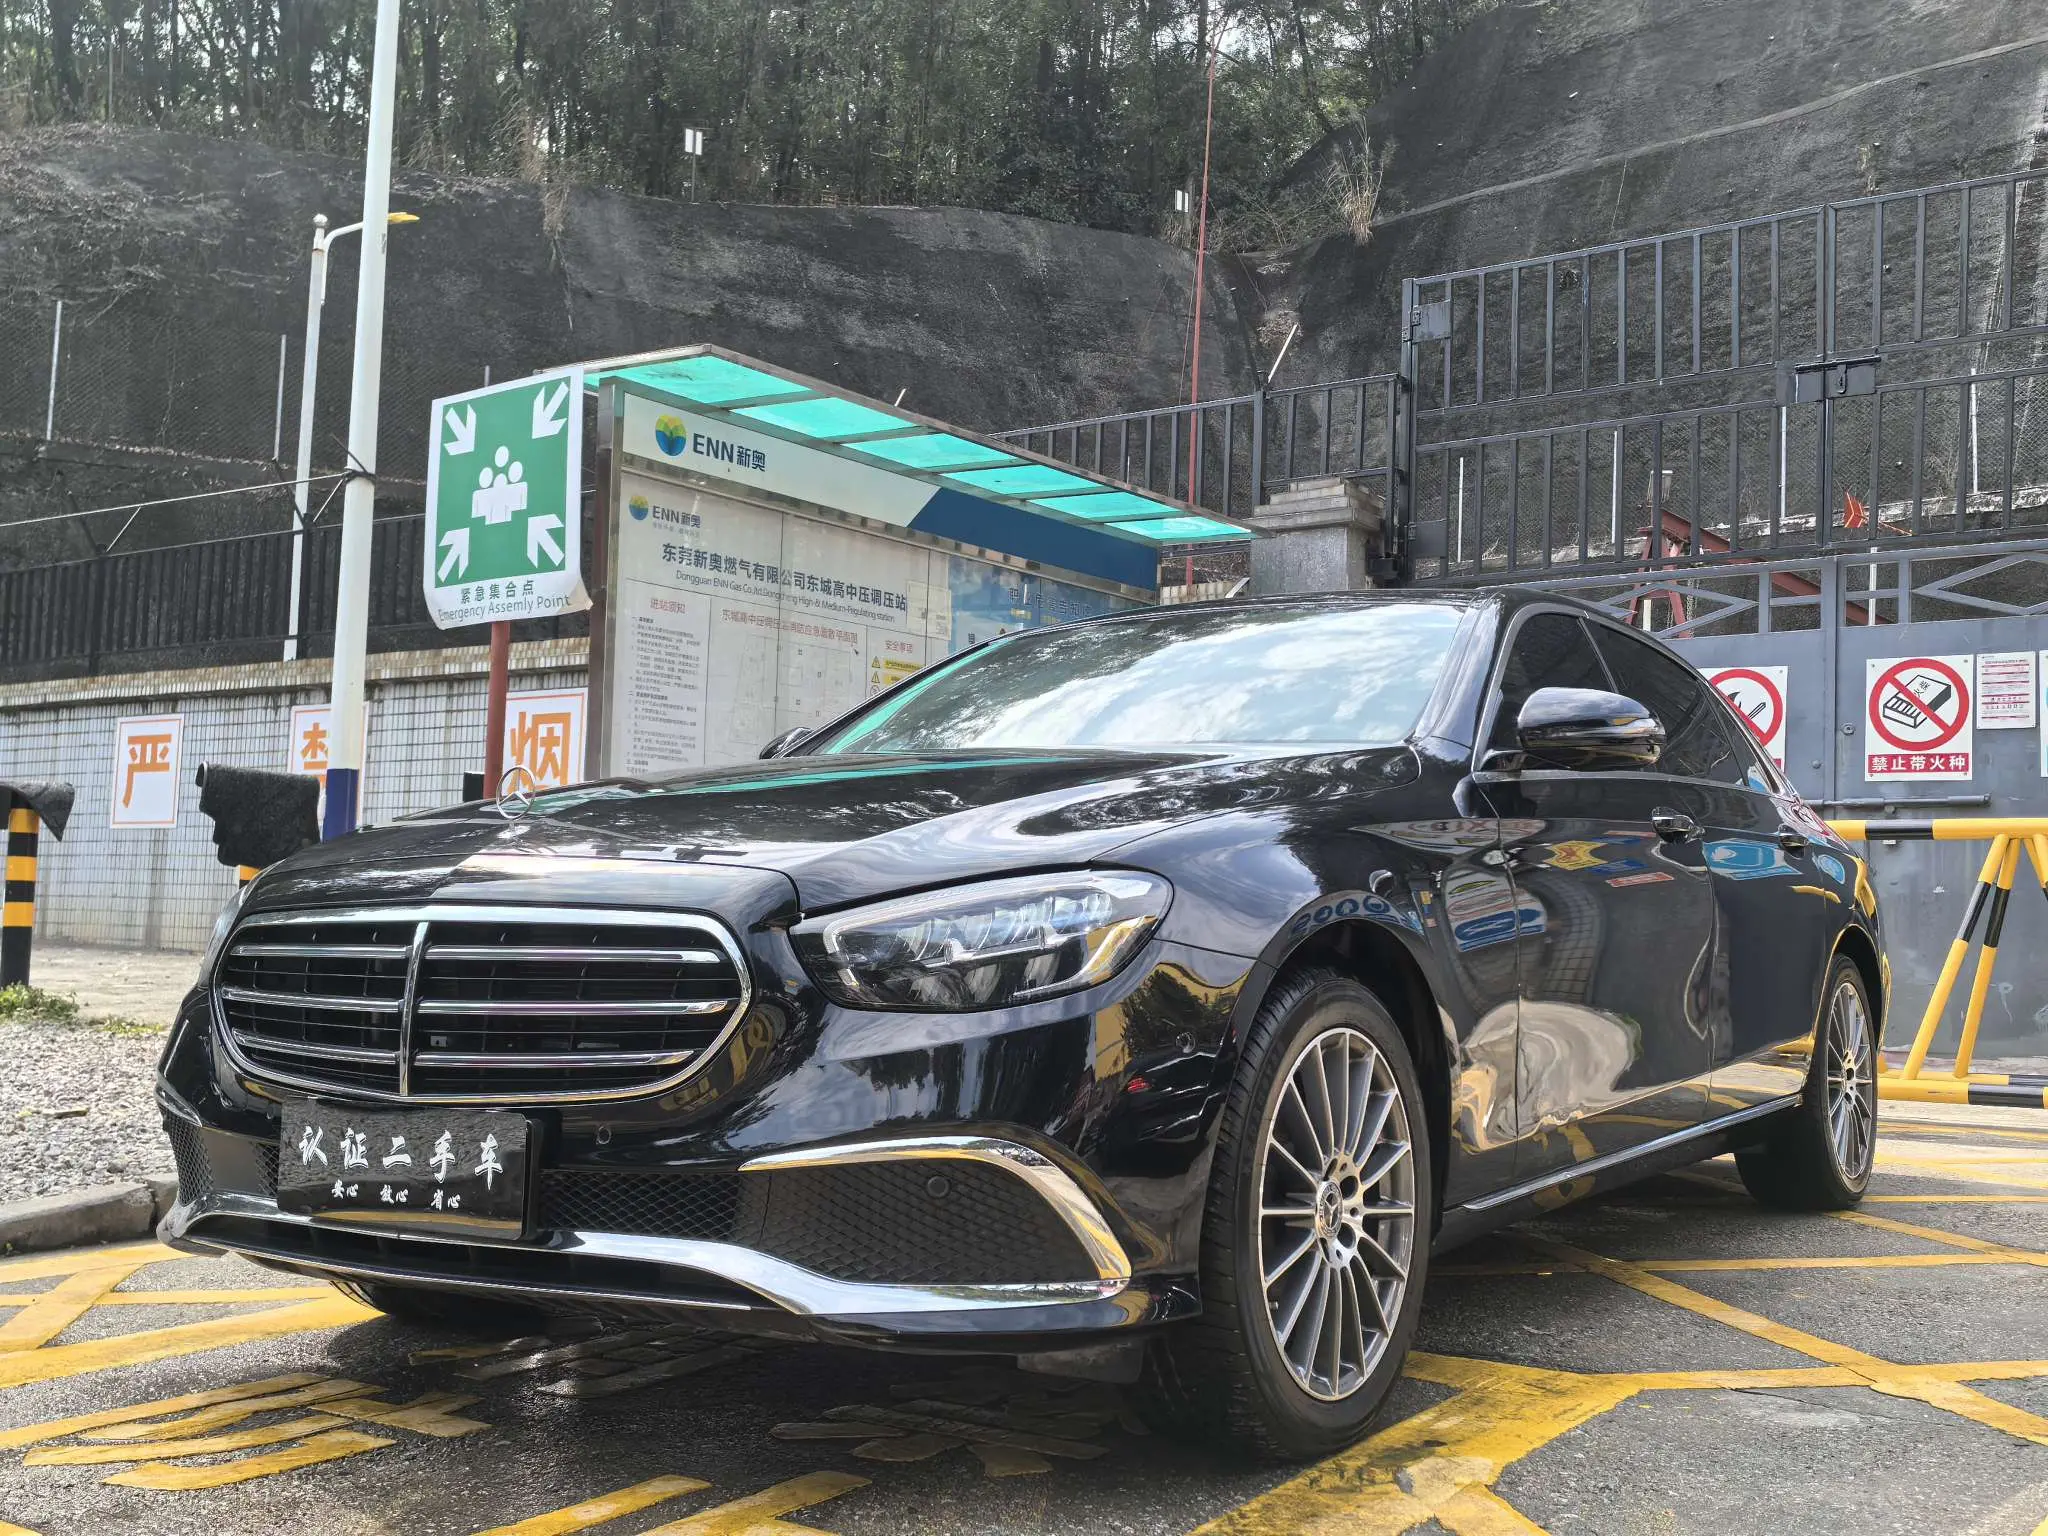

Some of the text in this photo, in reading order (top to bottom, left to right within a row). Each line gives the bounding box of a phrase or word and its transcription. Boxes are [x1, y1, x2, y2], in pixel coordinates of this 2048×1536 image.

[460, 579, 535, 605] 紧急集合点
[487, 597, 535, 616] Assemly
[537, 594, 571, 609] Point
[507, 711, 572, 793] 烟
[1871, 755, 1966, 771] 禁止带火种
[122, 733, 173, 808] 严
[298, 1125, 504, 1190] 认证二手车
[331, 1179, 461, 1211] 安心 放心 省心
